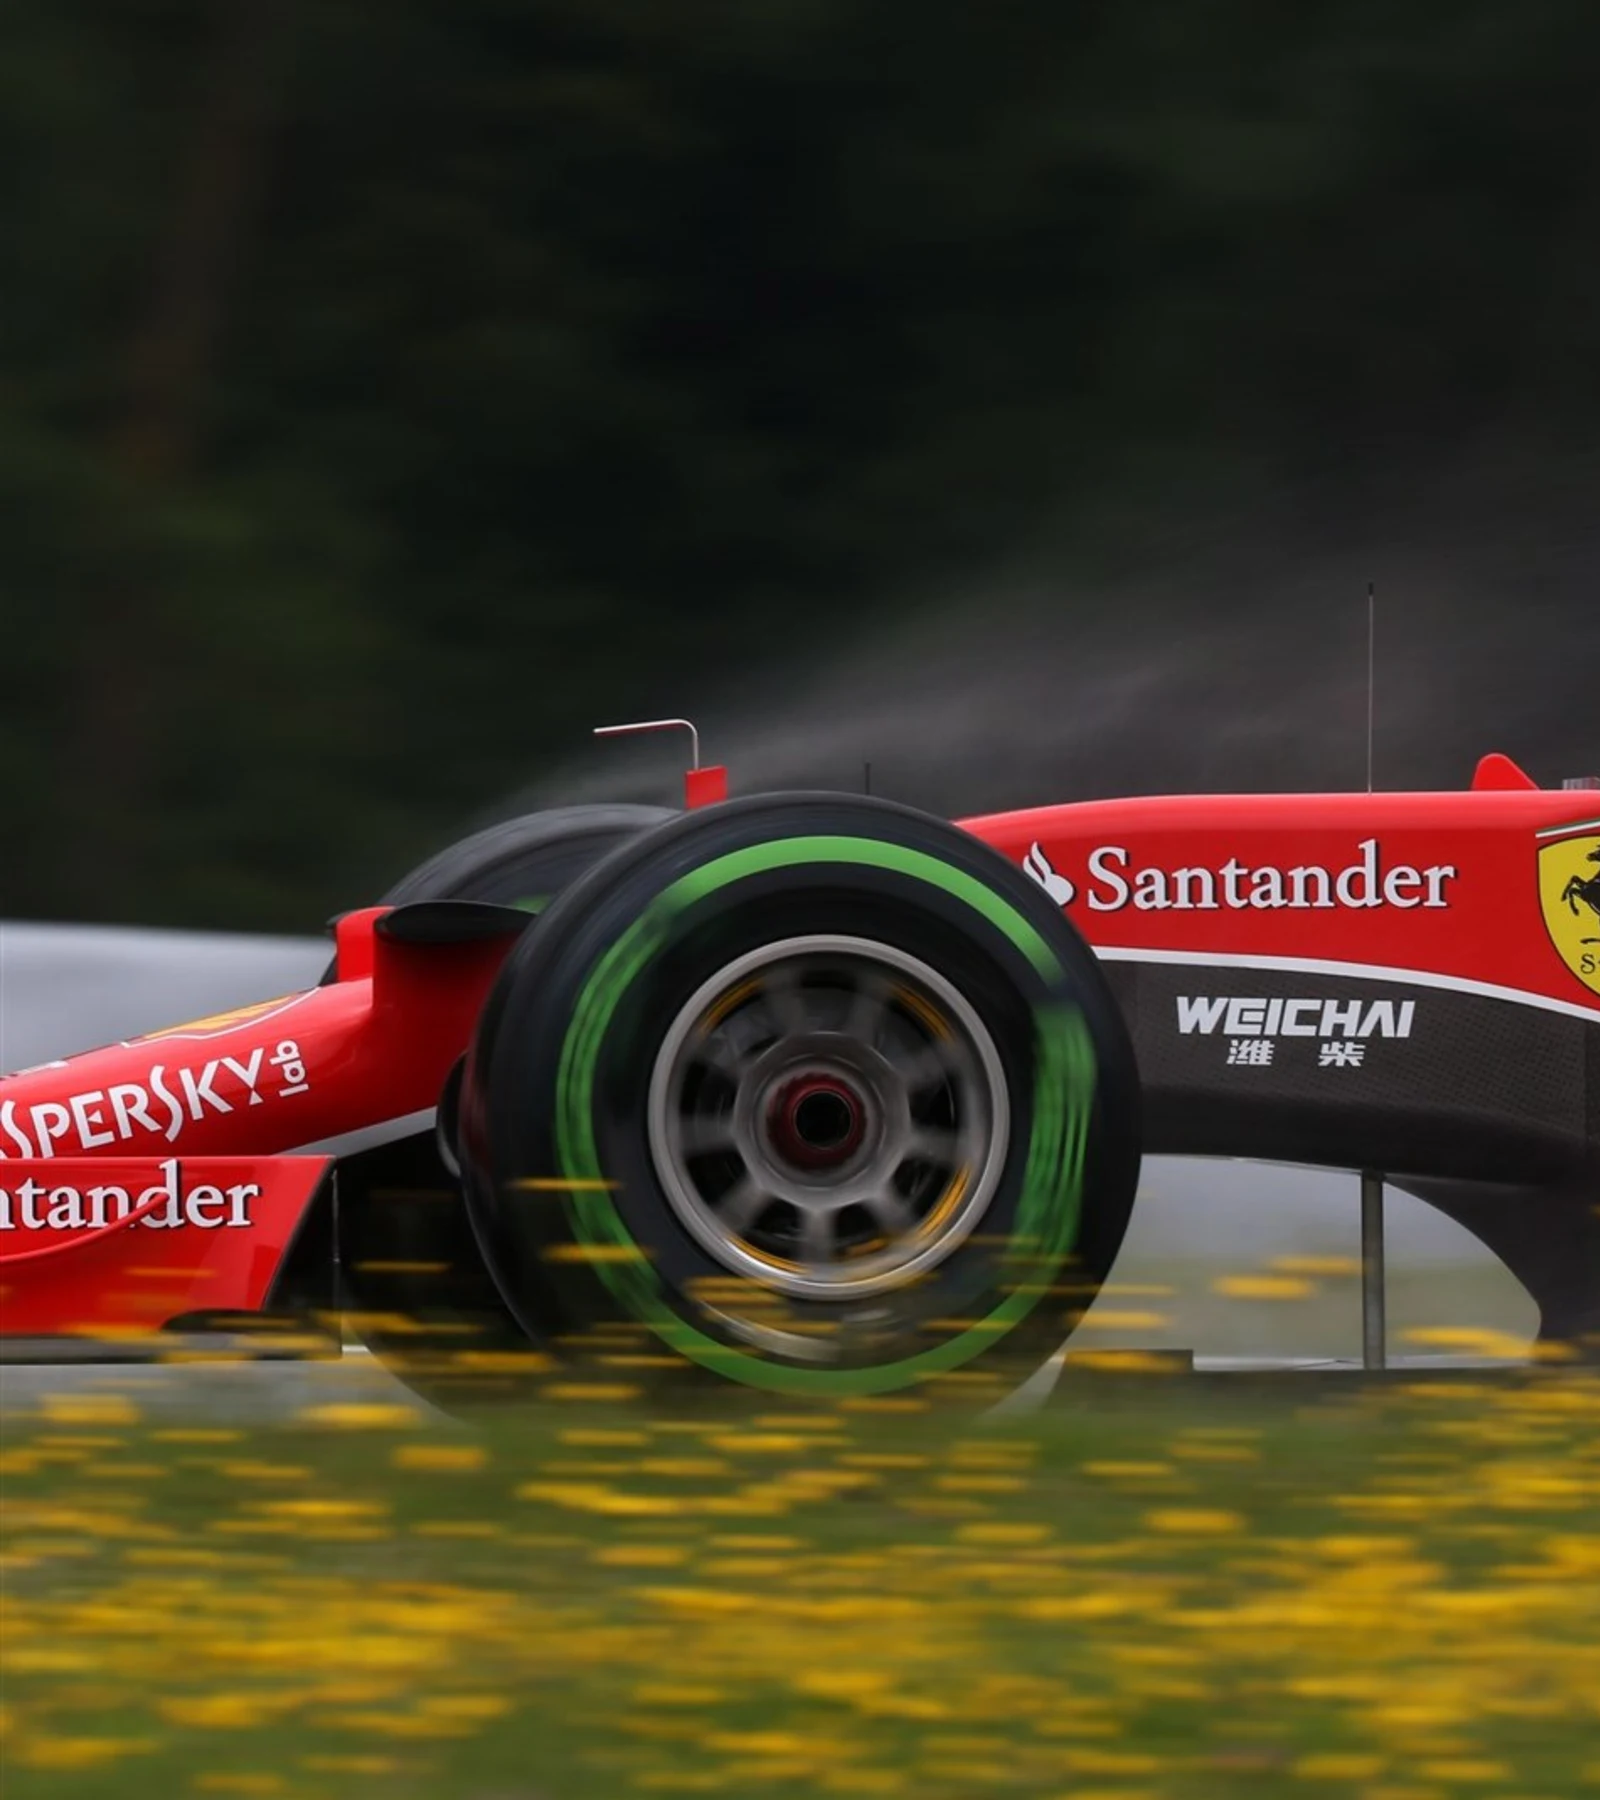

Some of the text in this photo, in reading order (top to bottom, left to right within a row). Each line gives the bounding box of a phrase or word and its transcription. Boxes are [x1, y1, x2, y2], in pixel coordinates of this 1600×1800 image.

[1087, 839, 1457, 910] Santander
[1176, 996, 1416, 1038] WEICHAI
[269, 1040, 310, 1098] lab
[0, 1047, 264, 1159] SPERSKY
